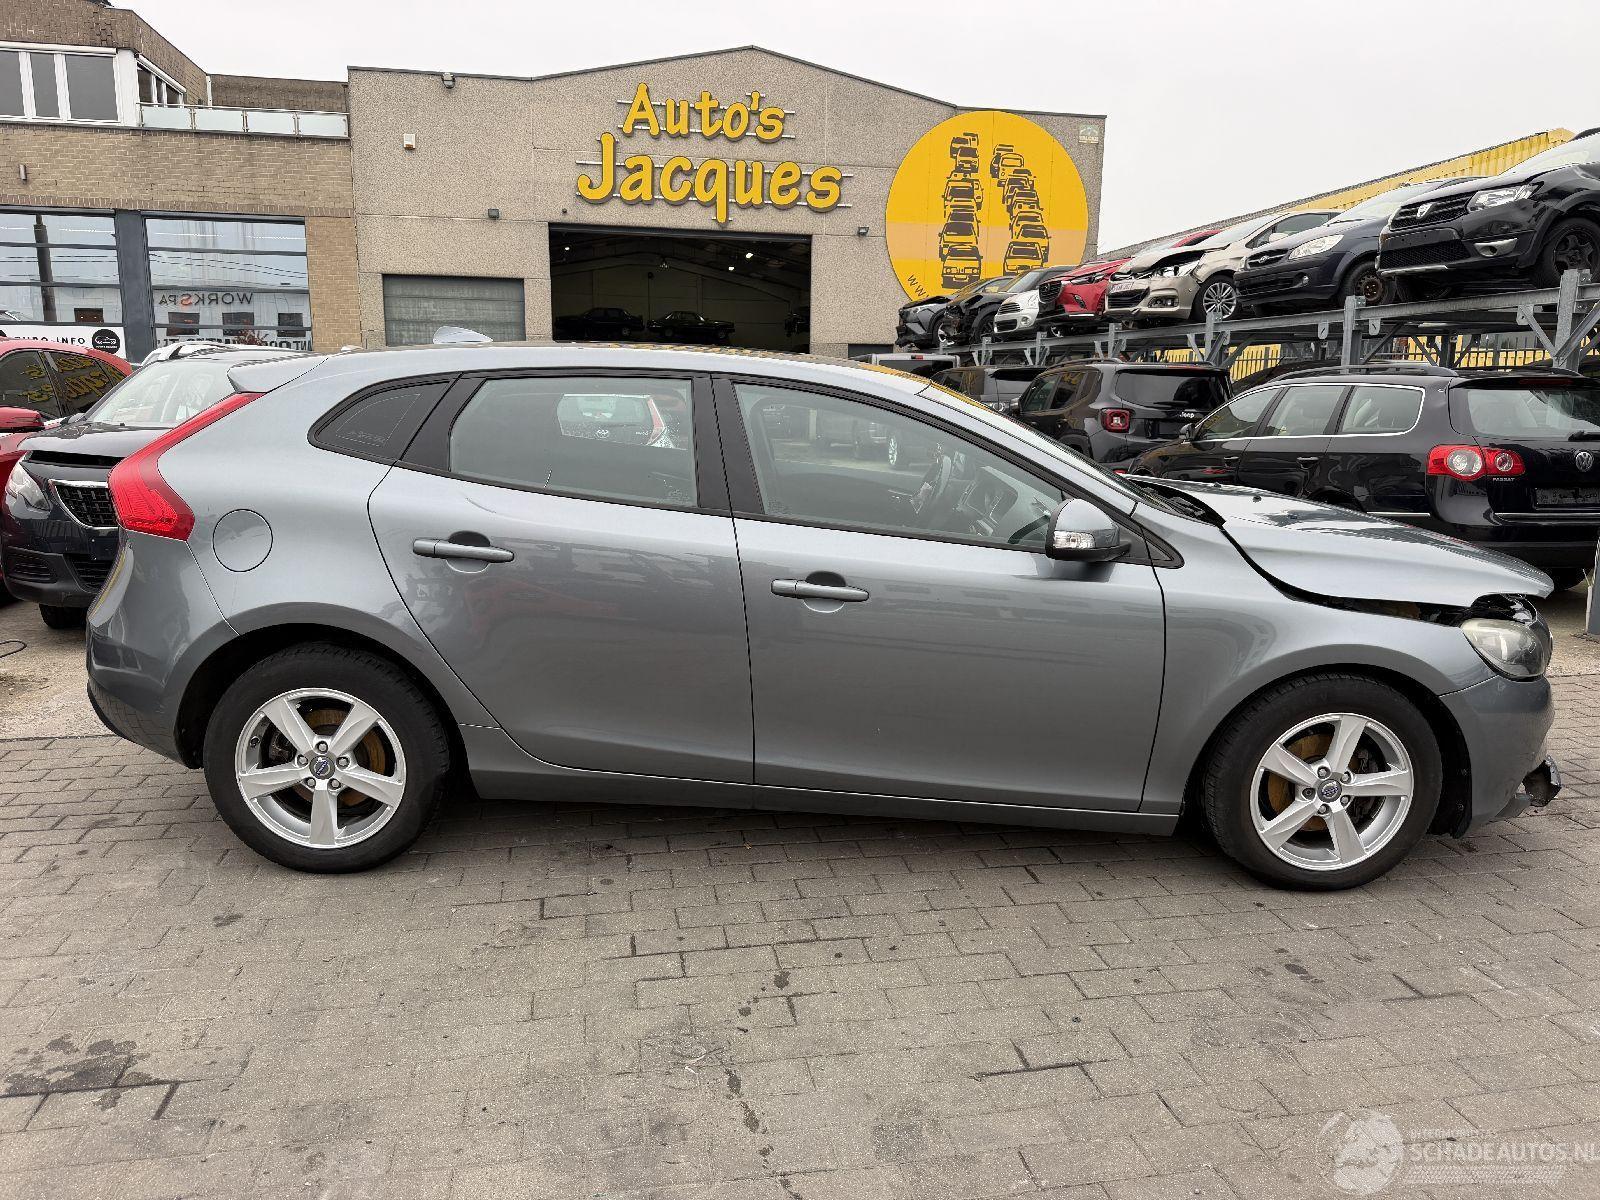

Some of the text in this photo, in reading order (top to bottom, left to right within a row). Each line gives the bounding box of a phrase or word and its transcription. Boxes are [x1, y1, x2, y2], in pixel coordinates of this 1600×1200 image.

[621, 82, 787, 143] Auto's
[576, 131, 844, 226] Jacques
[1179, 411, 1195, 419] Jeep
